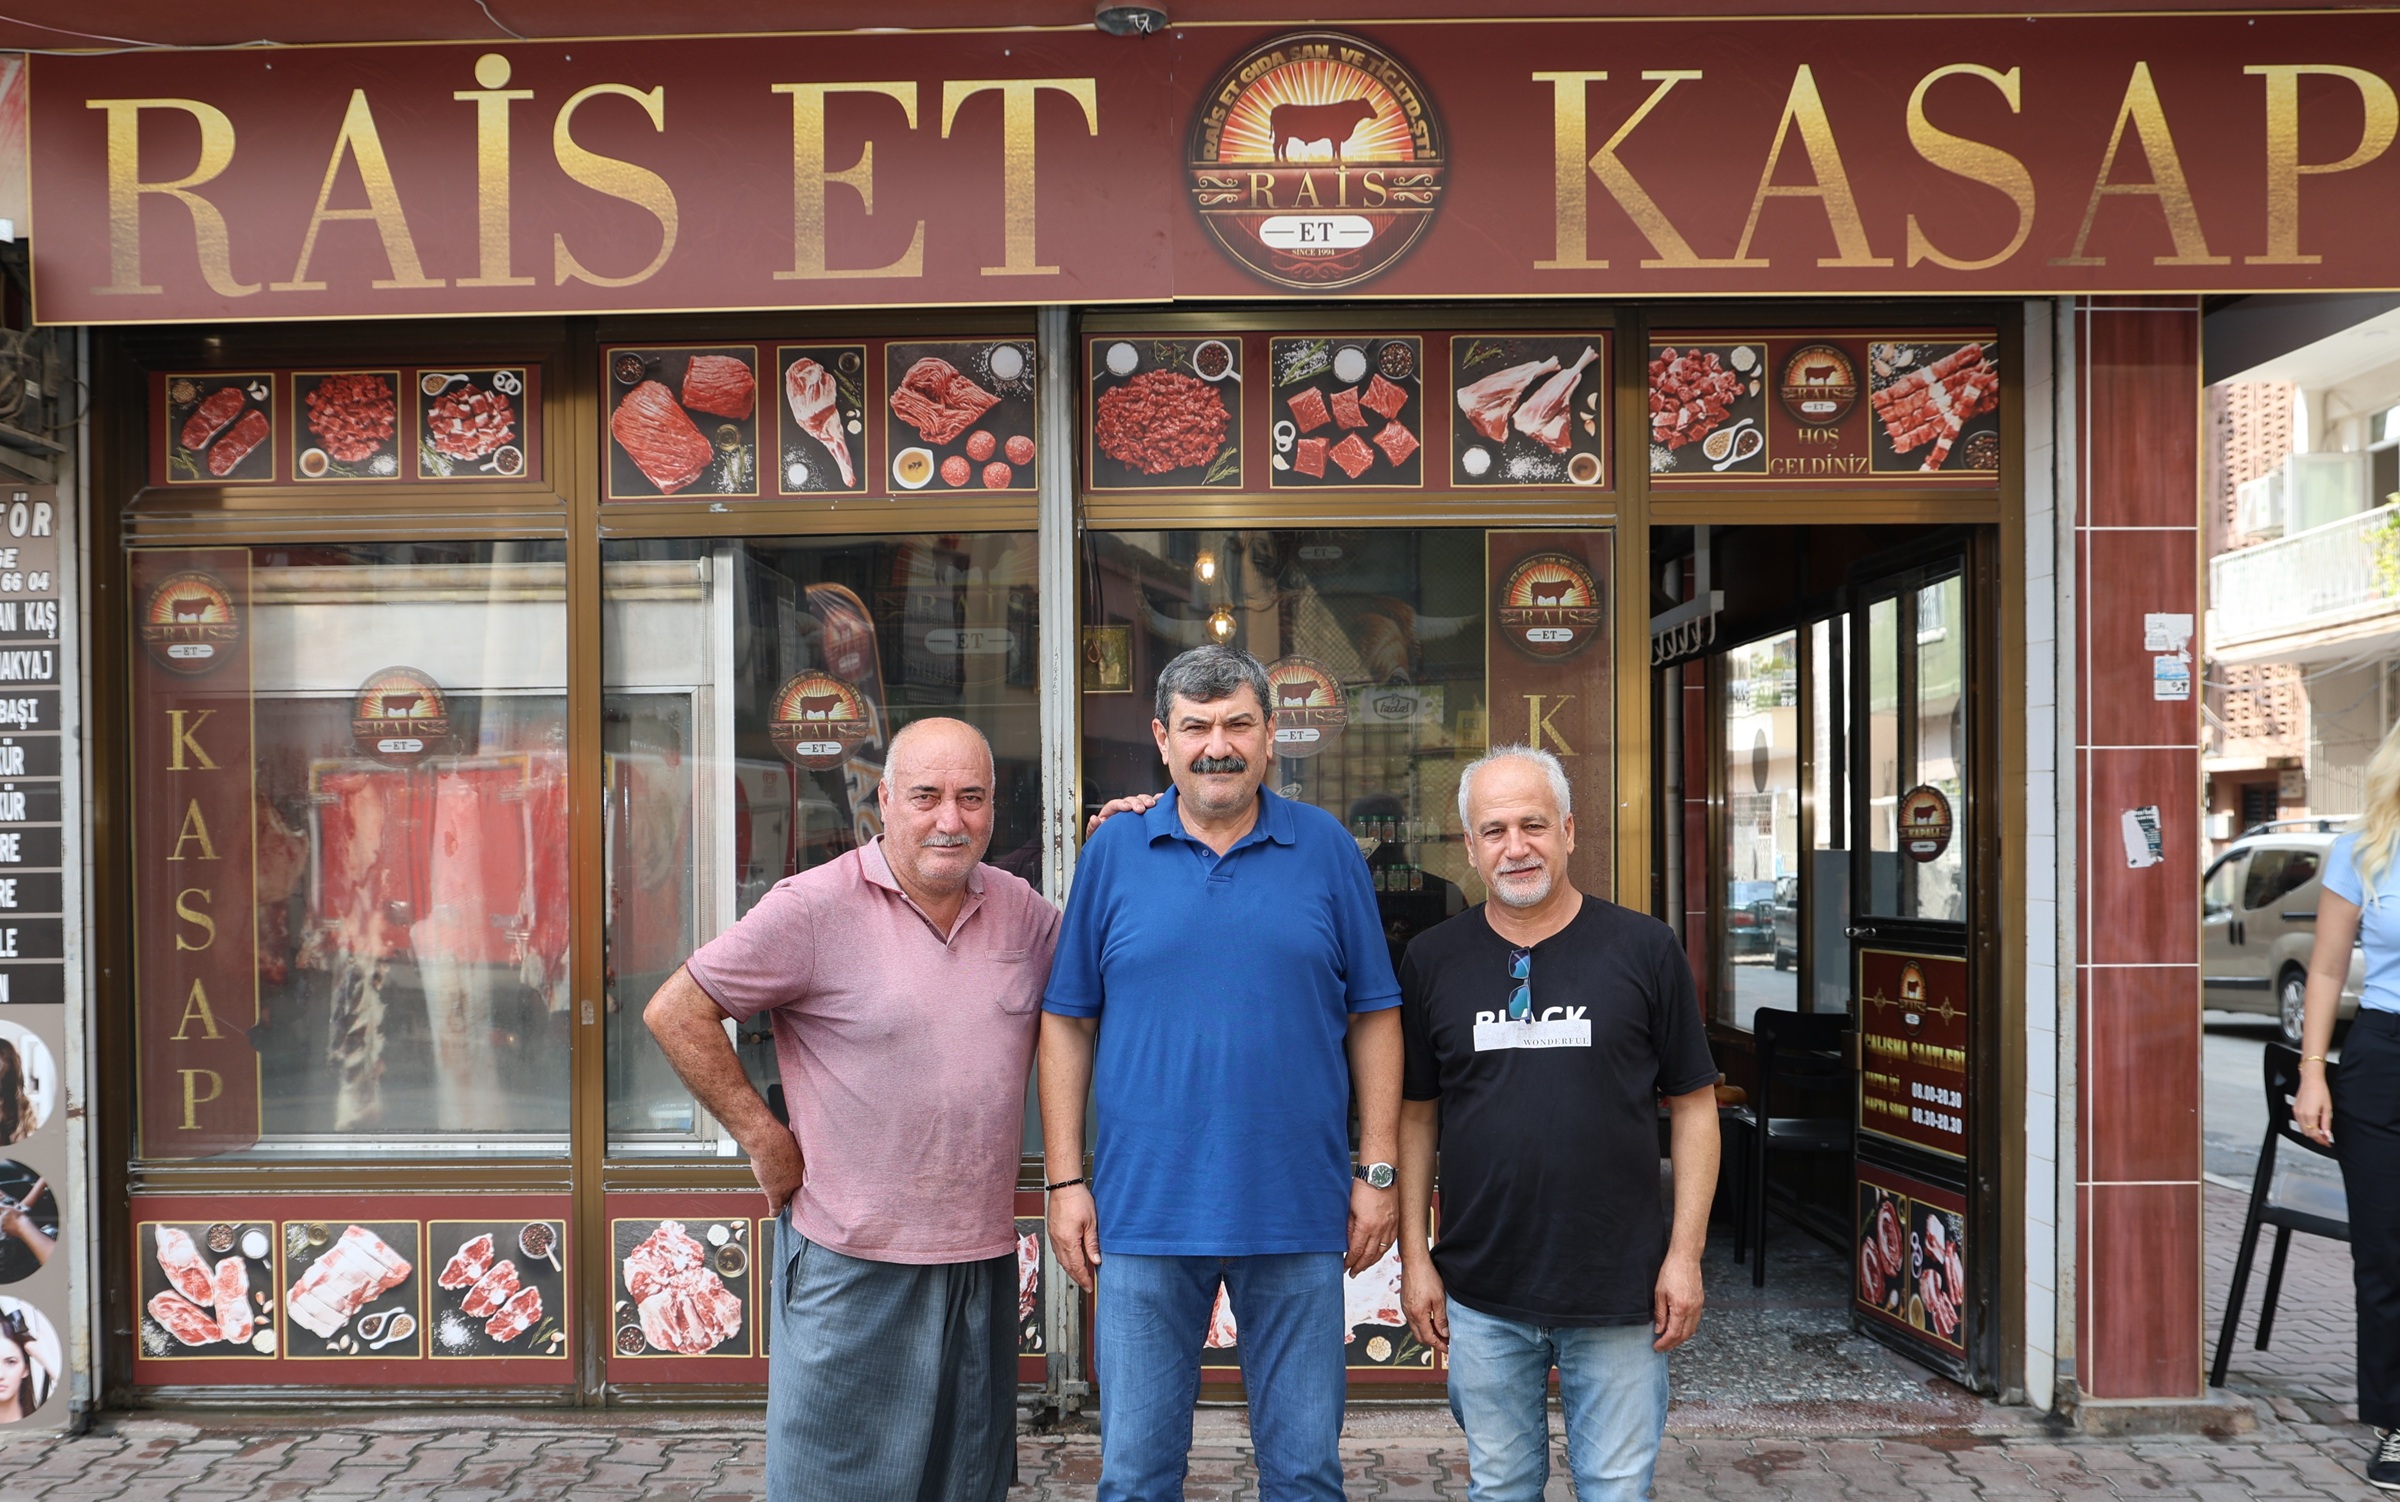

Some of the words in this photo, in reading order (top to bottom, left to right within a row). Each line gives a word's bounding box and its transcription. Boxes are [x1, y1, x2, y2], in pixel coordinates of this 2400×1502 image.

[1203, 105, 1227, 160] RAİS
[1219, 79, 1241, 107] ET
[1240, 51, 1286, 83] GIDA
[1289, 44, 1334, 60] SAN.
[1340, 47, 1366, 67] VE
[86, 53, 679, 297] RAİS
[771, 78, 1098, 281] ET
[1532, 61, 2400, 271] KASAP
[1247, 165, 1388, 209] RAİS
[1299, 222, 1334, 242] ET
[1291, 248, 1316, 256] SINCE
[1813, 403, 1825, 411] ET
[1798, 428, 1839, 450] HOŞ
[1770, 453, 1868, 475] GELDİNİZ
[0, 492, 52, 538] ÖR
[1, 572, 23, 592] 66
[27, 571, 50, 592] 04
[25, 601, 57, 639] KAŞ
[1522, 607, 1579, 624] RAİS
[956, 633, 984, 649] ET
[1542, 630, 1557, 640] ET
[183, 646, 198, 656] ET
[792, 721, 848, 739] RAİS
[1289, 731, 1304, 740] ET
[392, 741, 408, 751] ET
[812, 744, 827, 753] ET
[165, 709, 226, 1130] KASAP
[1523, 1037, 1589, 1047] WONDERFUL
